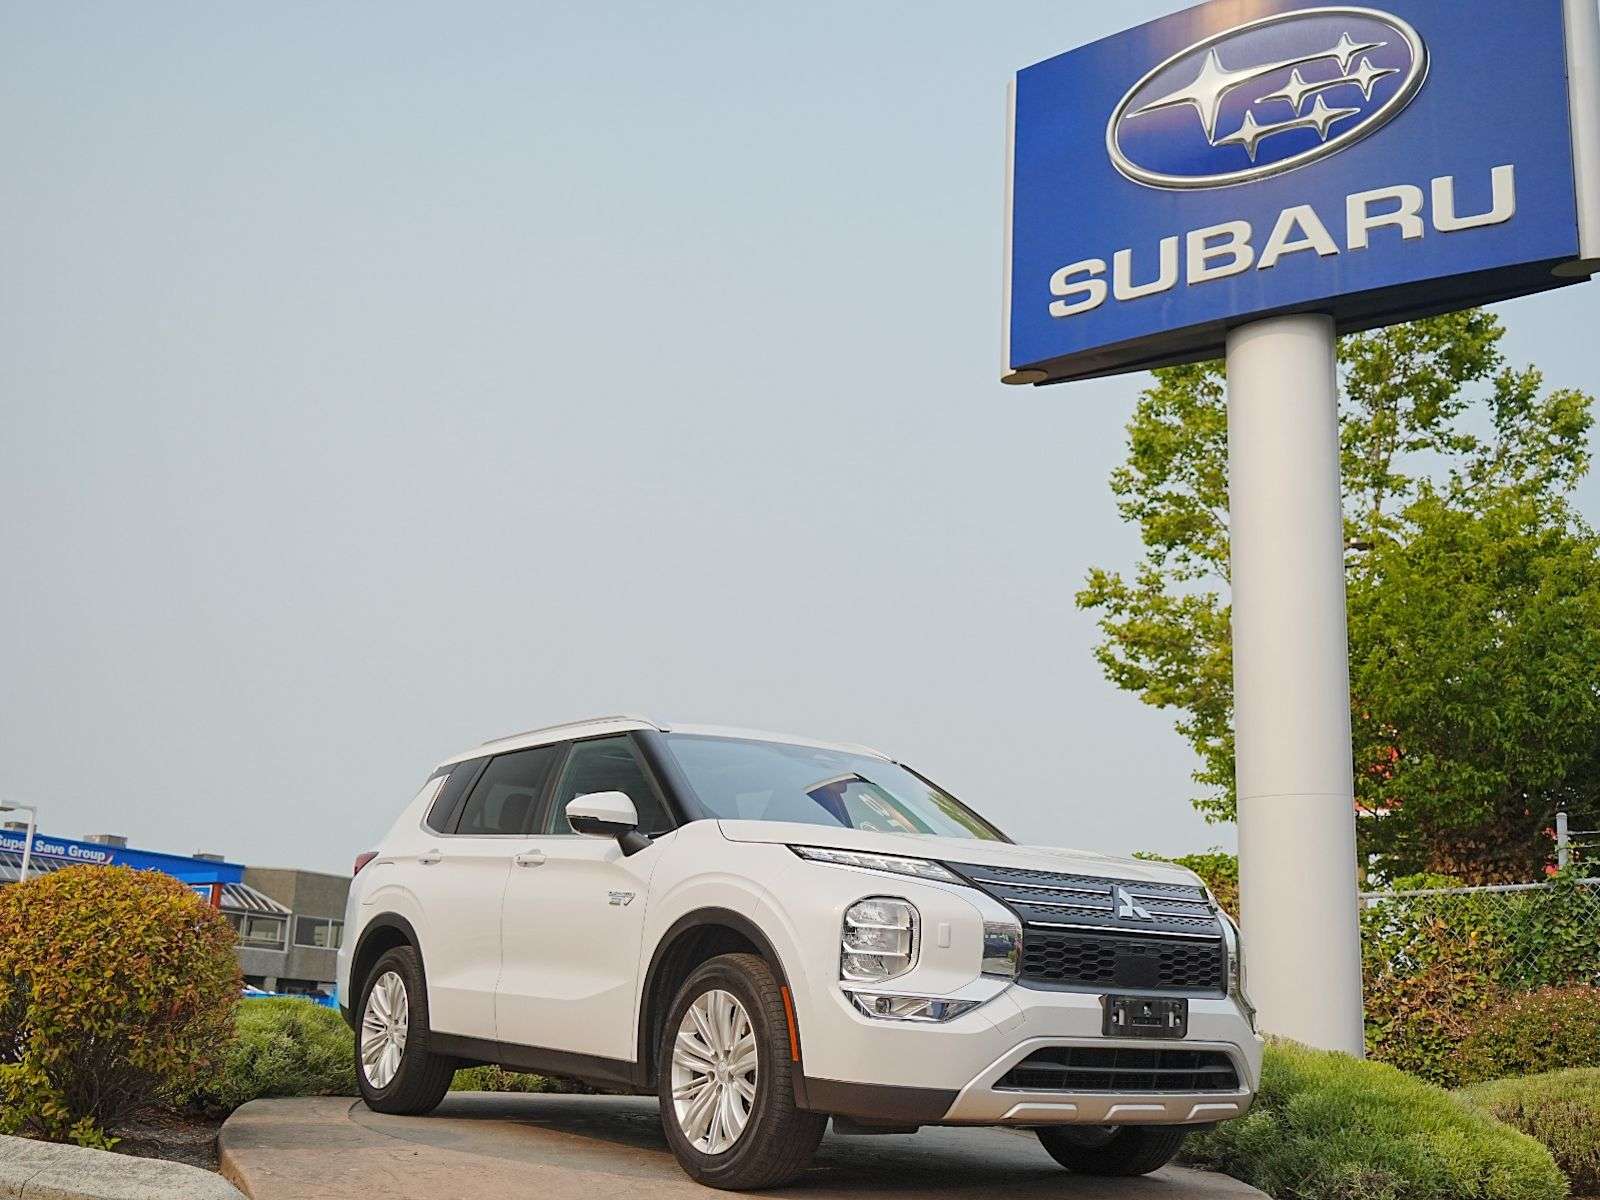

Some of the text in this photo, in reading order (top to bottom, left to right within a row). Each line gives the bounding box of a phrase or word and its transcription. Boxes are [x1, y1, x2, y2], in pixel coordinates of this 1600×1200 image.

[1048, 164, 1516, 318] SUBARU
[35, 840, 65, 855] Save
[68, 845, 106, 863] Group
